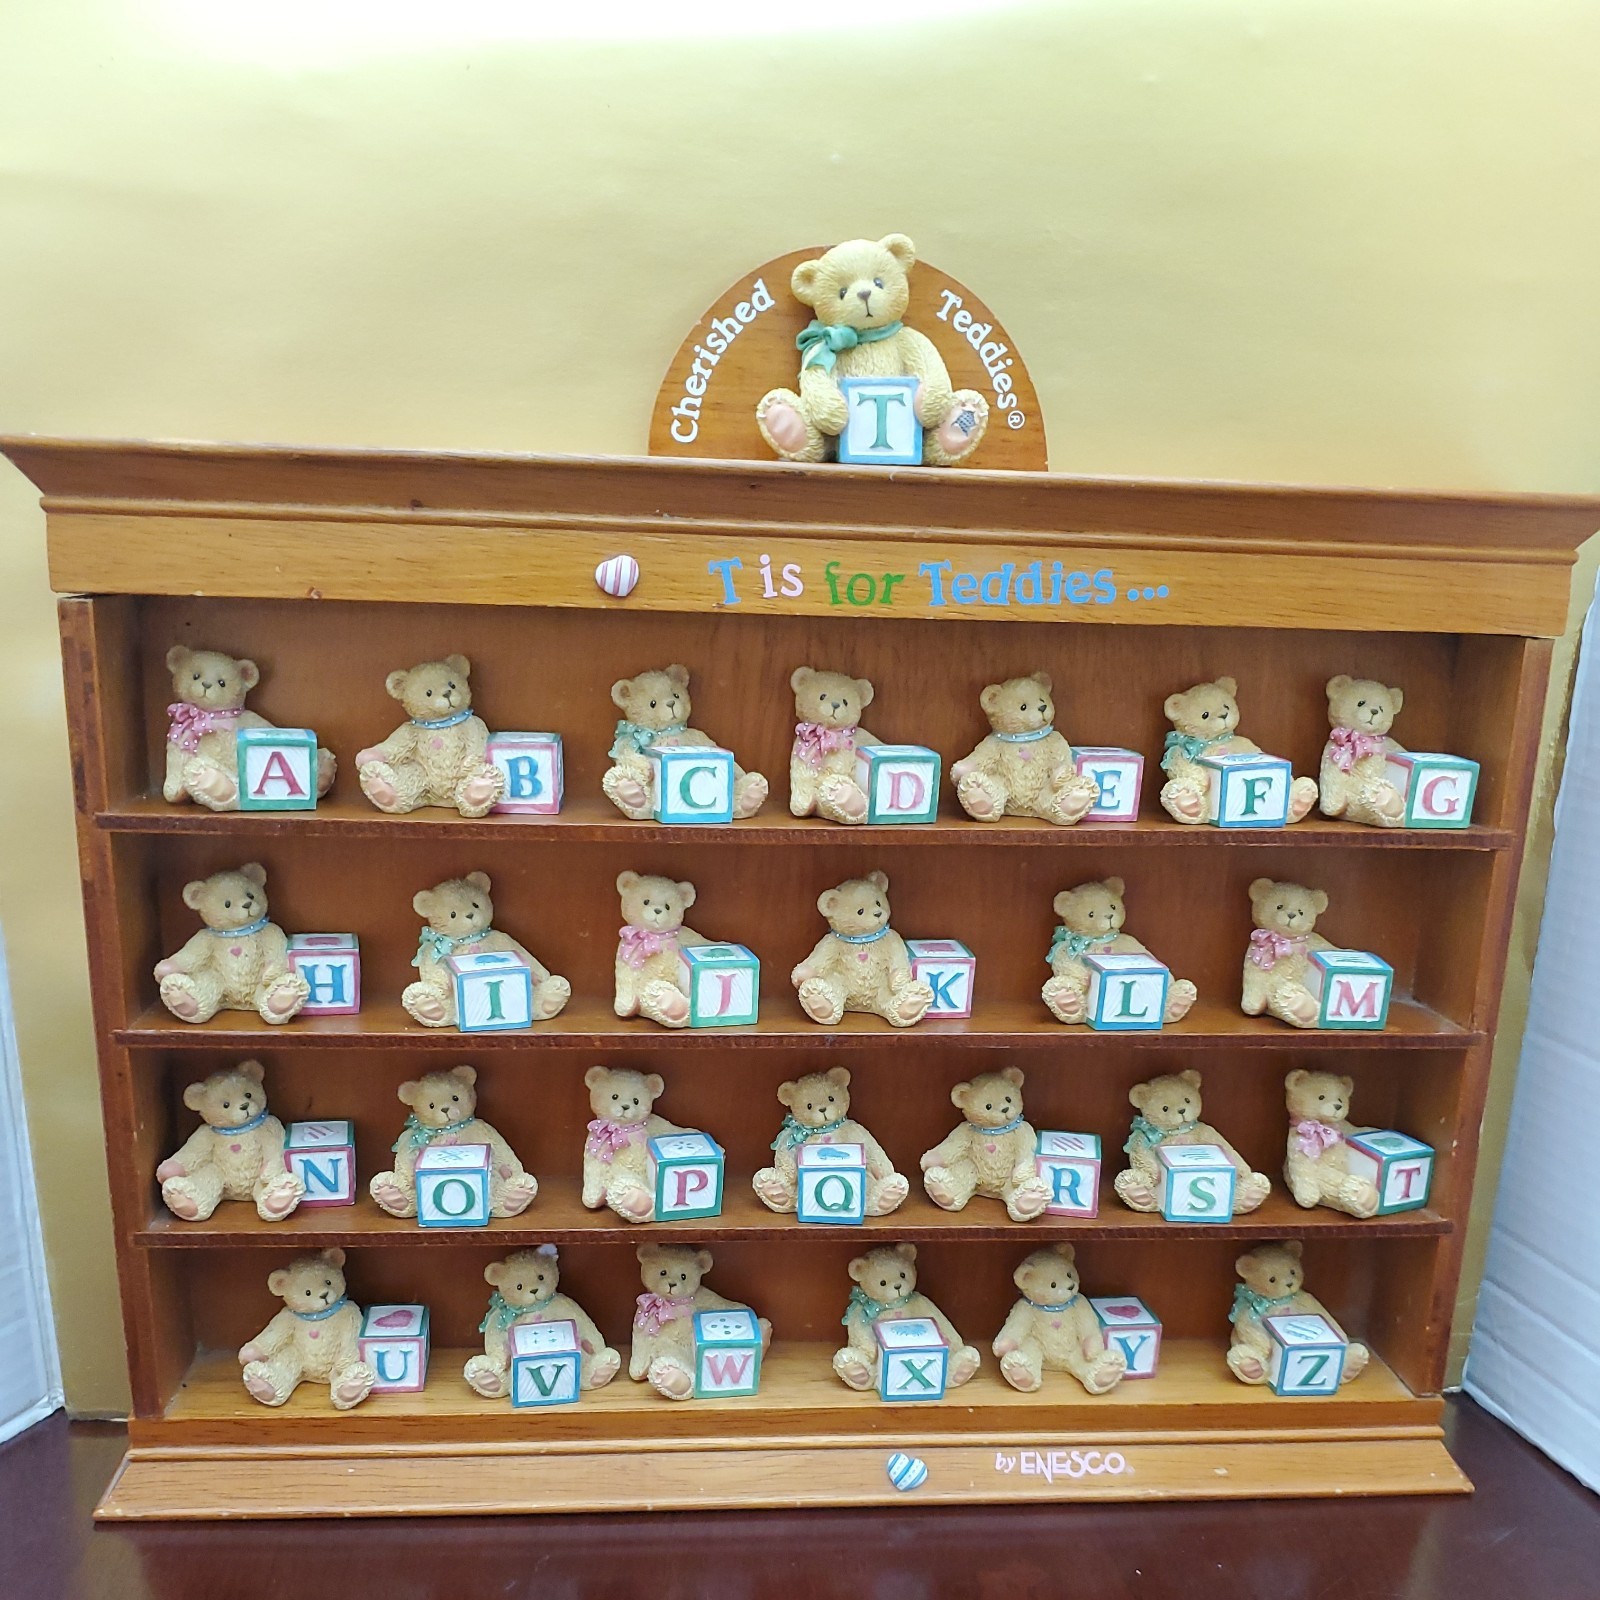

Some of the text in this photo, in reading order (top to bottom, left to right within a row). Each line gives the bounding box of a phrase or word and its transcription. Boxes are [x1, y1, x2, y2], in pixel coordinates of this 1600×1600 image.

[670, 278, 775, 443] Cherished
[856, 391, 908, 450] T
[708, 556, 743, 606] T
[759, 554, 804, 599] is
[824, 561, 906, 607] for
[253, 751, 305, 796] A
[505, 755, 543, 798] B
[678, 766, 719, 809] C
[887, 772, 924, 811] D
[1091, 769, 1122, 809] E
[1244, 777, 1274, 815] F
[1421, 775, 1458, 816] G
[300, 964, 347, 1003] H
[486, 979, 508, 1021] I
[713, 973, 736, 1017] J
[927, 971, 966, 1010] K
[1116, 980, 1149, 1018] L
[1329, 981, 1379, 1018] M
[299, 1157, 341, 1194] N
[674, 1170, 708, 1206] P
[813, 1175, 856, 1212] Q
[1053, 1170, 1086, 1208] R
[1394, 1167, 1421, 1201] T
[433, 1179, 475, 1217] O
[1189, 1177, 1217, 1213] S
[375, 1350, 412, 1382] U
[705, 1354, 751, 1386] W
[1112, 1336, 1149, 1372] Y
[1297, 1353, 1330, 1387] Z
[525, 1366, 566, 1397] V
[898, 1358, 936, 1391] X
[995, 1452, 1017, 1474] by
